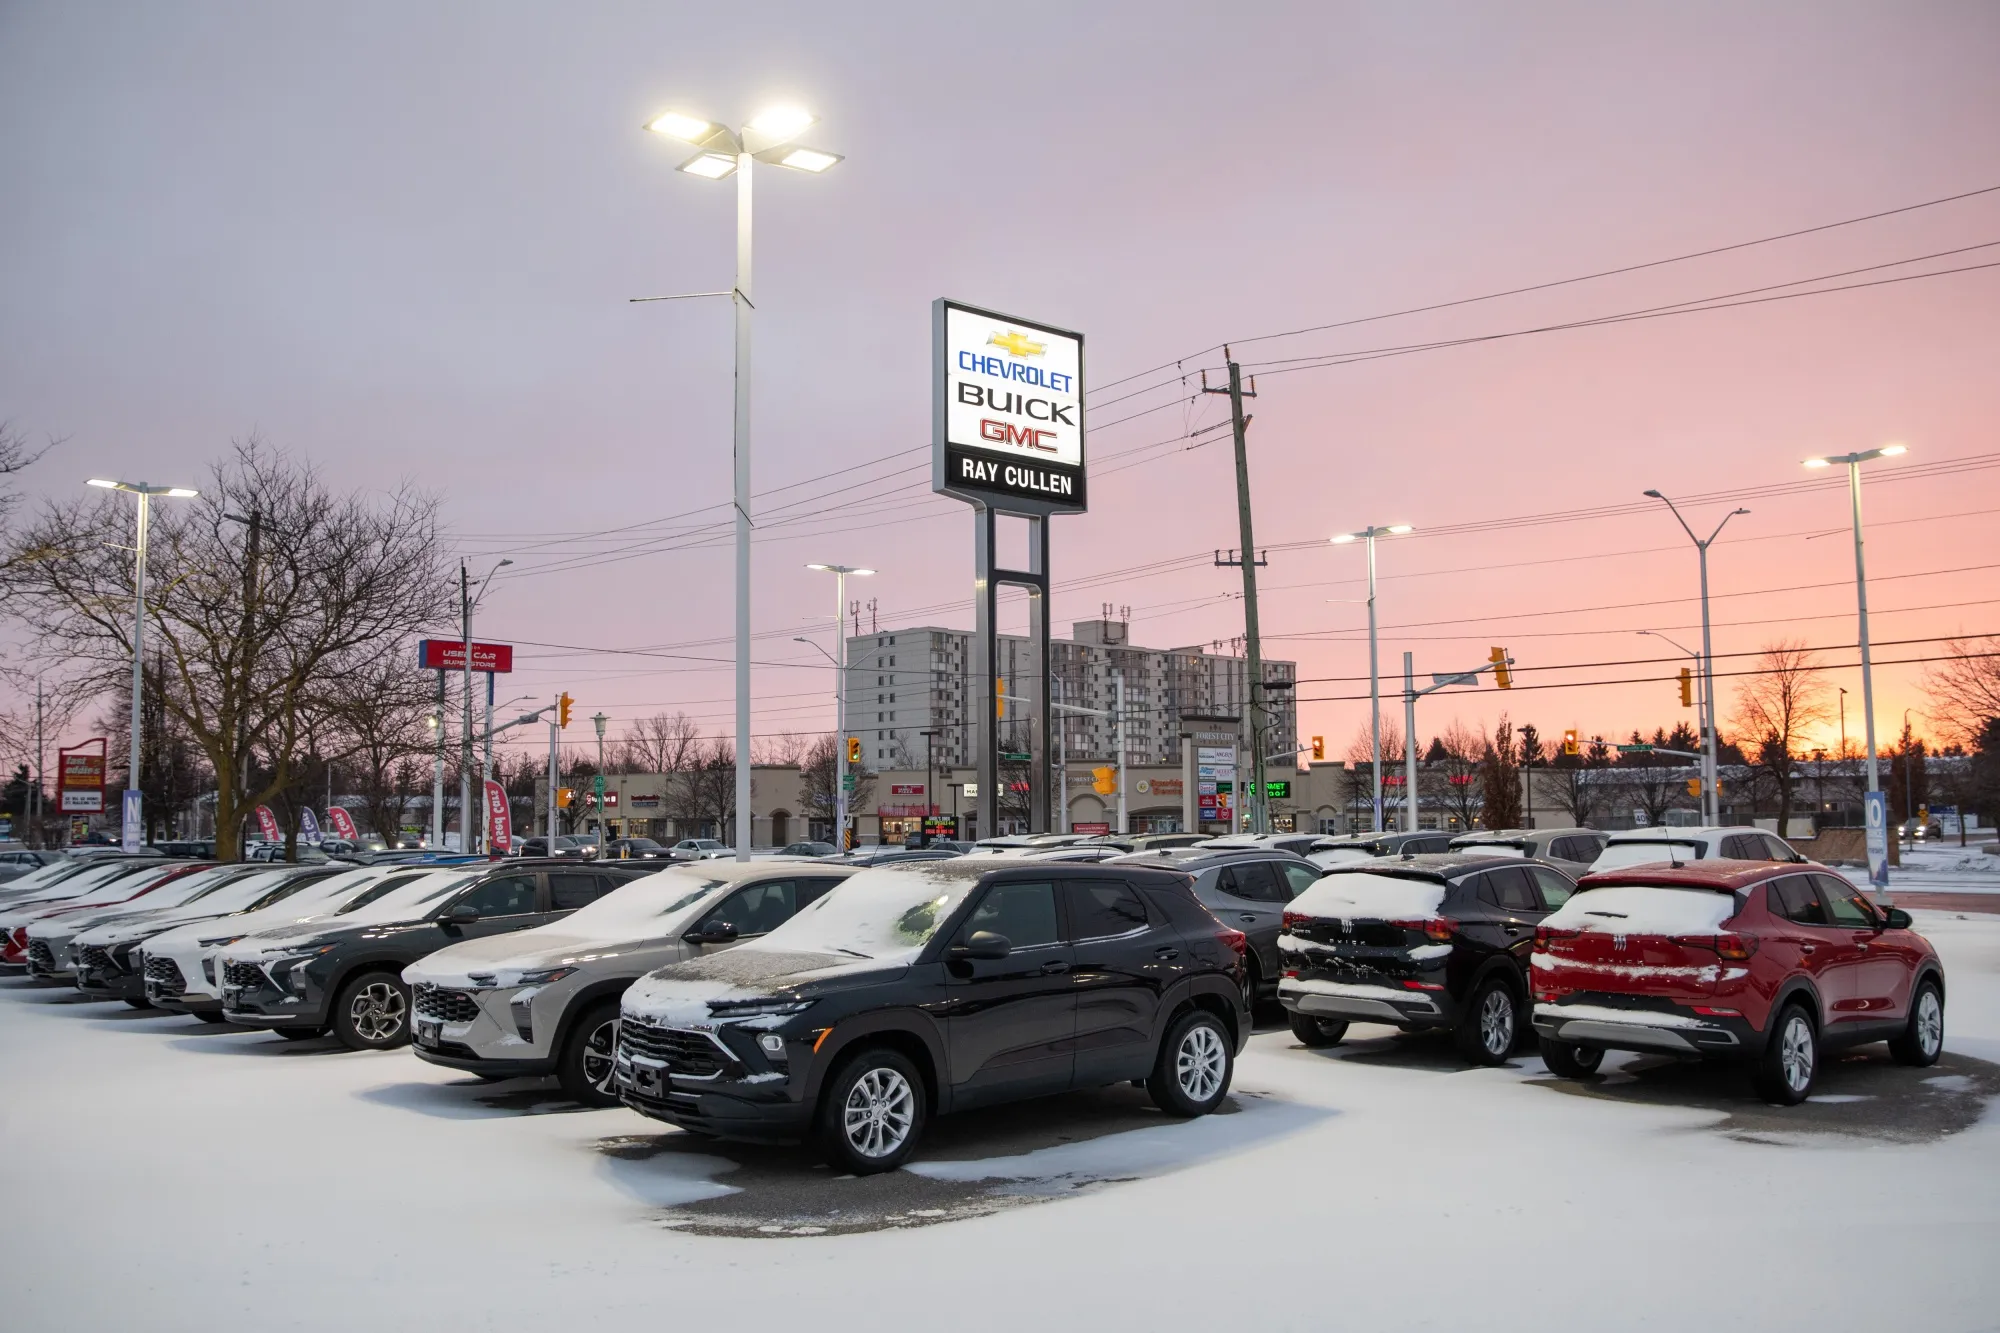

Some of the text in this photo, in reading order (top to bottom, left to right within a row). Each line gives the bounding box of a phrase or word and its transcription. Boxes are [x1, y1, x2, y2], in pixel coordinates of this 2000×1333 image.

[958, 350, 1073, 393] CHEVROLET
[958, 381, 1076, 427] BUICK
[979, 417, 1059, 454] GMC
[962, 457, 1072, 495] RAY CULLEN
[473, 652, 496, 660] CAR
[443, 659, 496, 668] SUPESTORE
[1196, 731, 1235, 741] FOREST CITY
[1250, 782, 1286, 790] GRMET
[1636, 815, 1646, 823] 40
